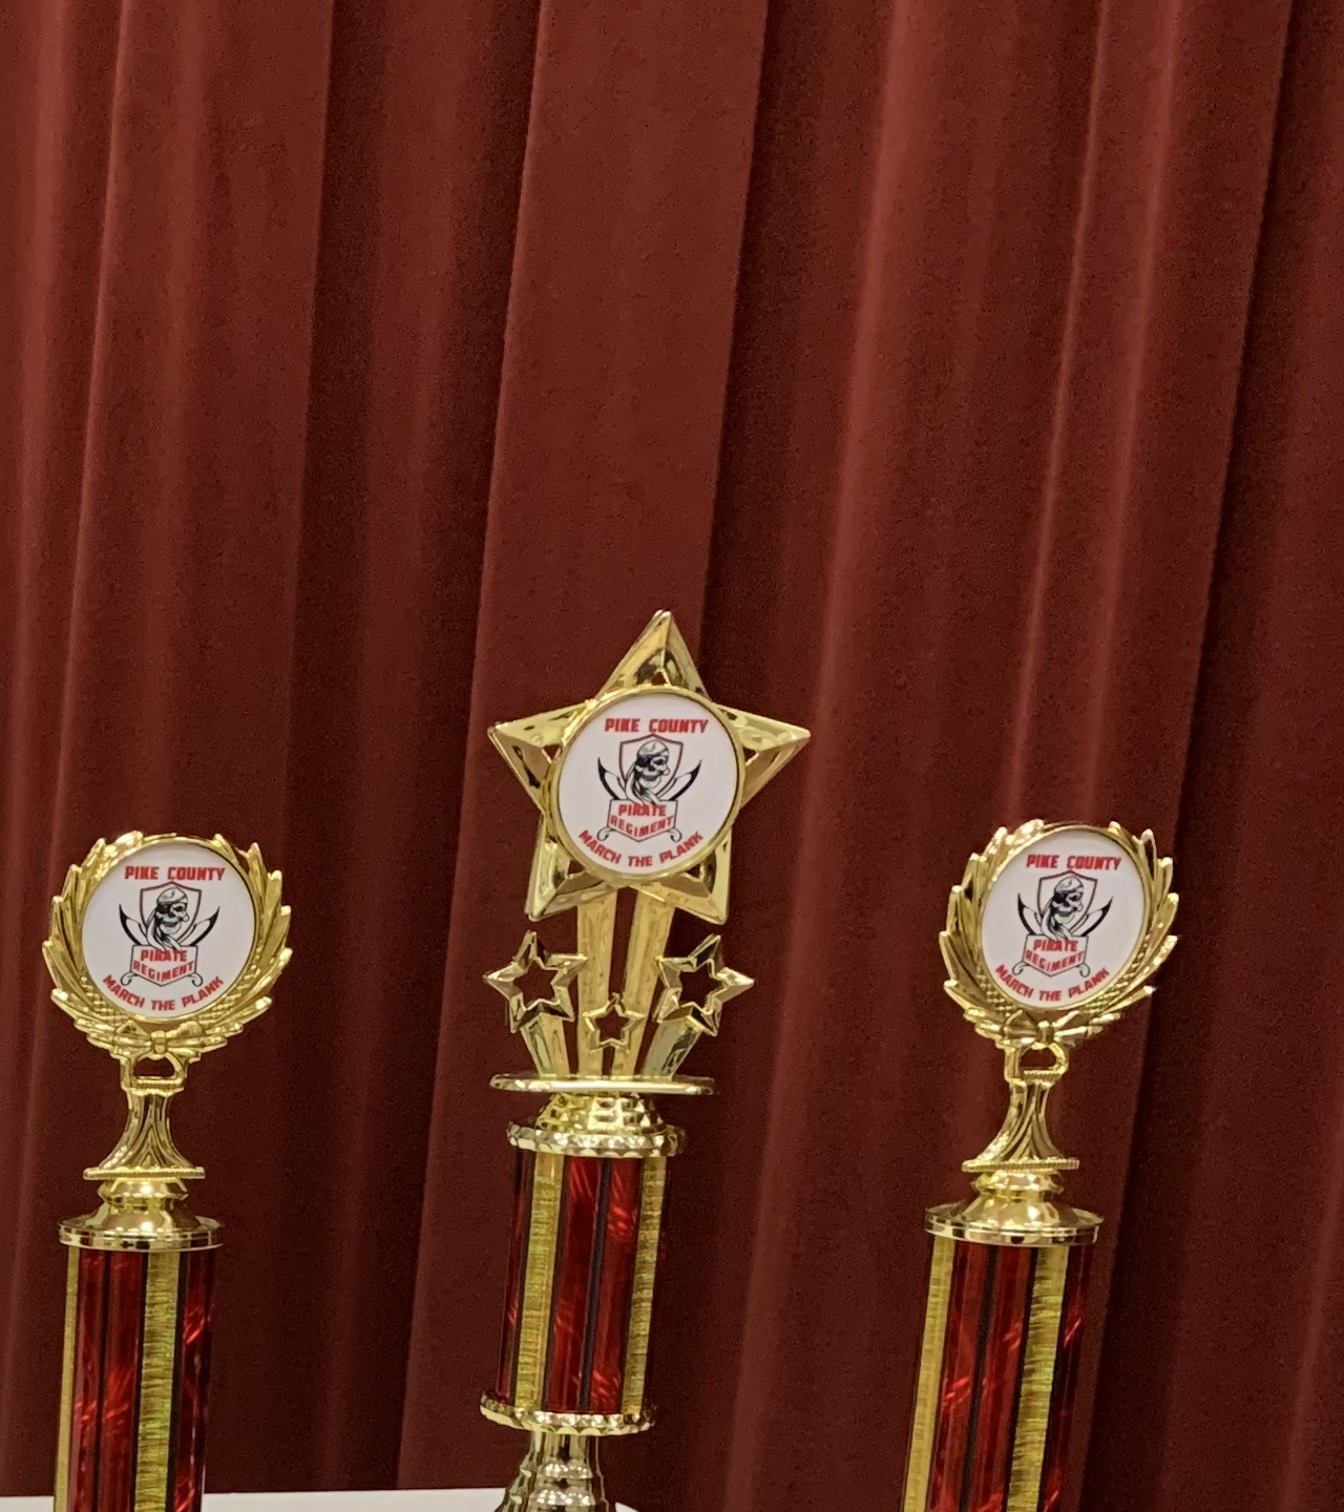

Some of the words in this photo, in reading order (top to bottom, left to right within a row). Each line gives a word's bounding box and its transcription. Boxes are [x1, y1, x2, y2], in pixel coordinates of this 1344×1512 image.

[605, 718, 640, 732] PIKE
[649, 719, 709, 733] COUNTY
[618, 804, 667, 817] PIRATE
[610, 815, 675, 837] REGIMENT
[579, 830, 622, 864] MARCH
[628, 856, 652, 867] THE
[659, 831, 703, 863] PLANK
[1026, 854, 1060, 868] PIKE
[1067, 855, 1121, 870] COUNTY
[125, 866, 159, 880] PIKE
[168, 867, 225, 880] COUNTY
[1033, 939, 1078, 951] PIRATE
[140, 950, 187, 962] PIRATE
[1025, 950, 1085, 972] REGIMENT
[132, 960, 194, 982] REGIMENT
[996, 965, 1034, 998] MARCH
[1039, 990, 1061, 1001] THE
[1068, 968, 1110, 998] PLANK
[103, 975, 145, 1008] MARCH
[151, 1000, 176, 1011] THE
[182, 976, 224, 1008] PLANK
